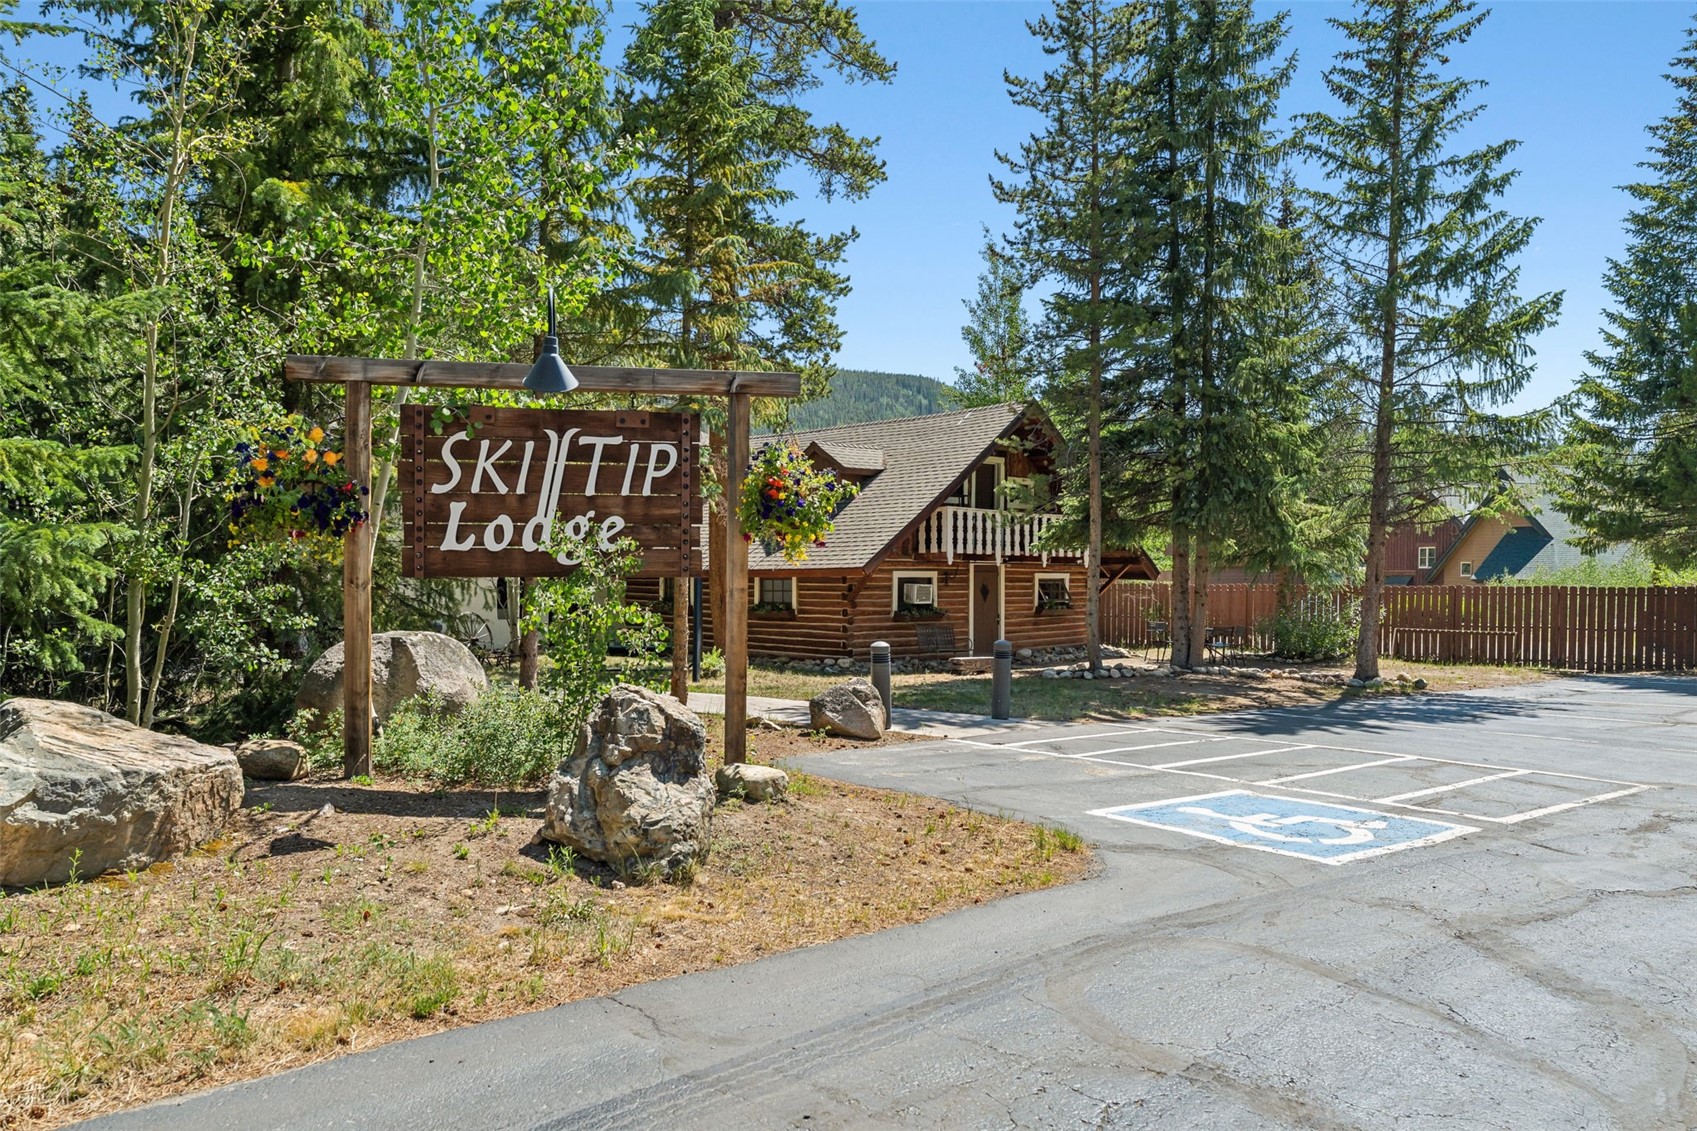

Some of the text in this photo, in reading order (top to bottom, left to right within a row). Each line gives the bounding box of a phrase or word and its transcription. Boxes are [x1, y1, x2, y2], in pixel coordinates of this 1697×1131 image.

[431, 430, 678, 497] SKI TIP
[440, 501, 626, 566] Lodge
